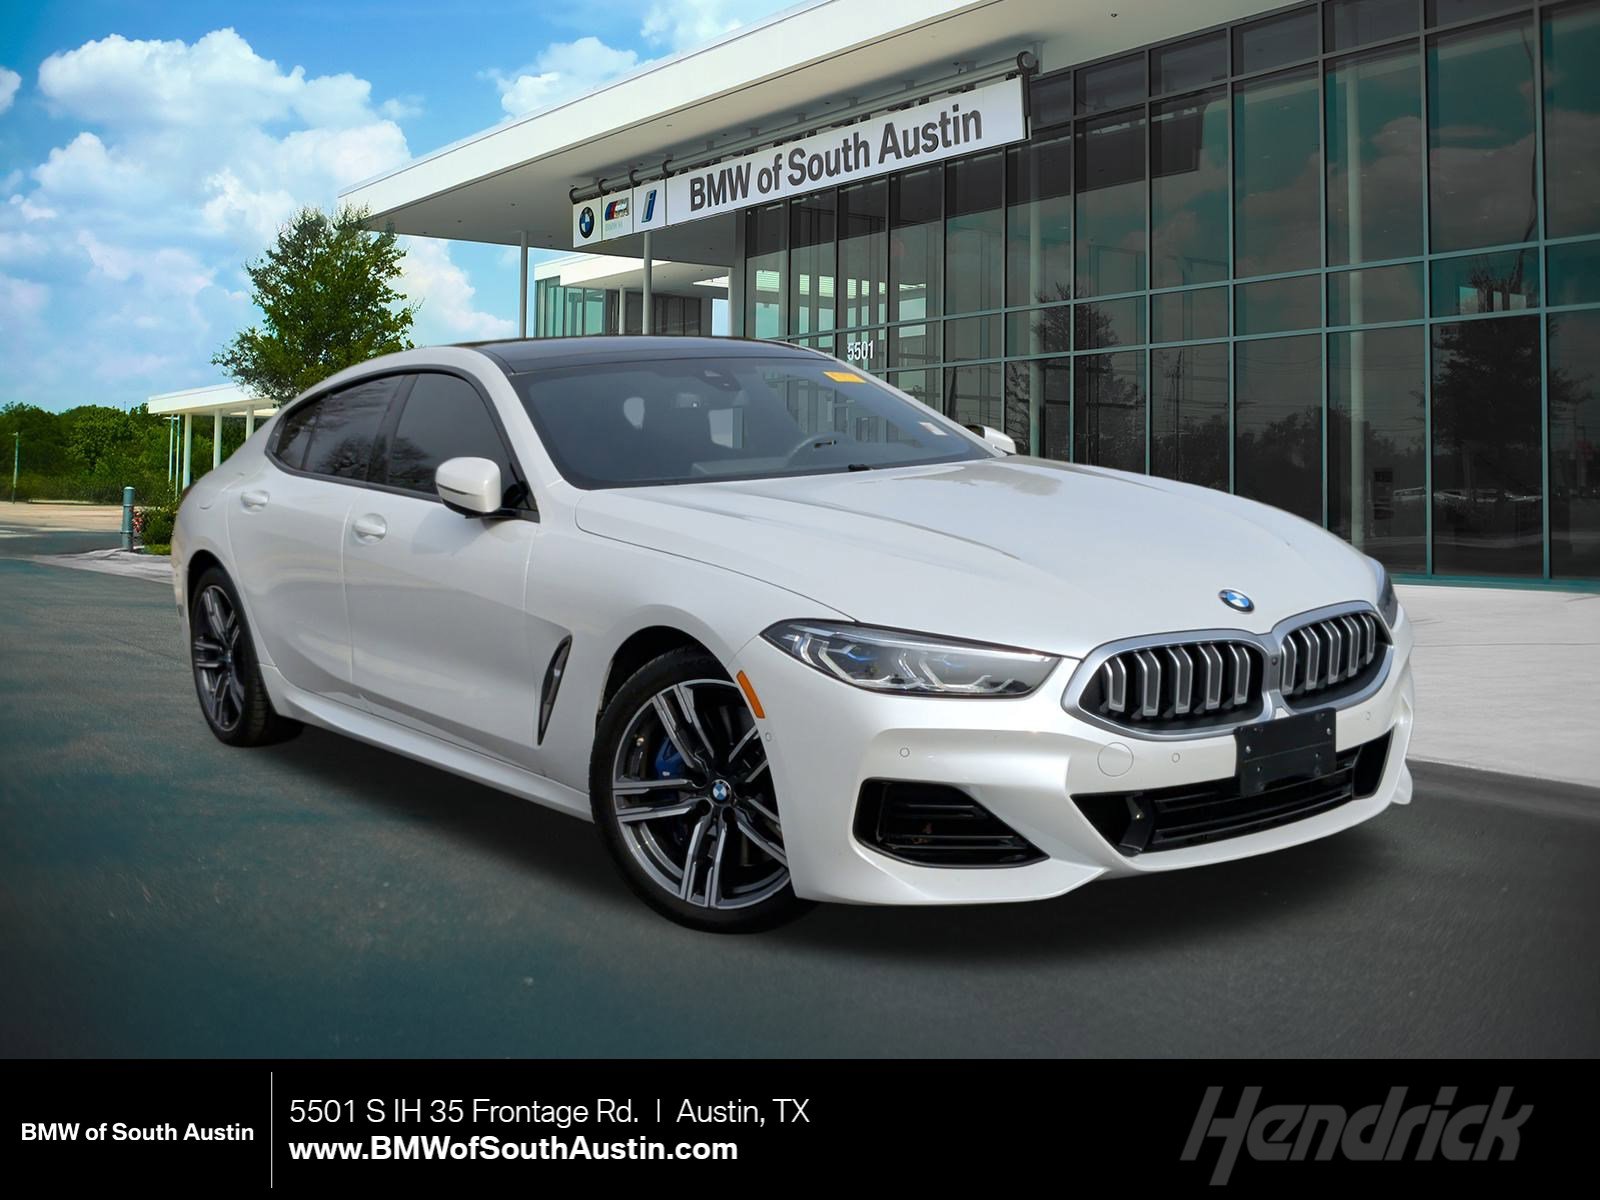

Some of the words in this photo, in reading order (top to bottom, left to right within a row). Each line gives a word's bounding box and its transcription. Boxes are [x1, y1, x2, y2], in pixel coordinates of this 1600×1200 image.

[690, 162, 751, 212] BMW
[757, 153, 782, 194] of
[787, 131, 870, 187] South
[878, 103, 983, 164] Austin
[847, 340, 874, 361] 5501
